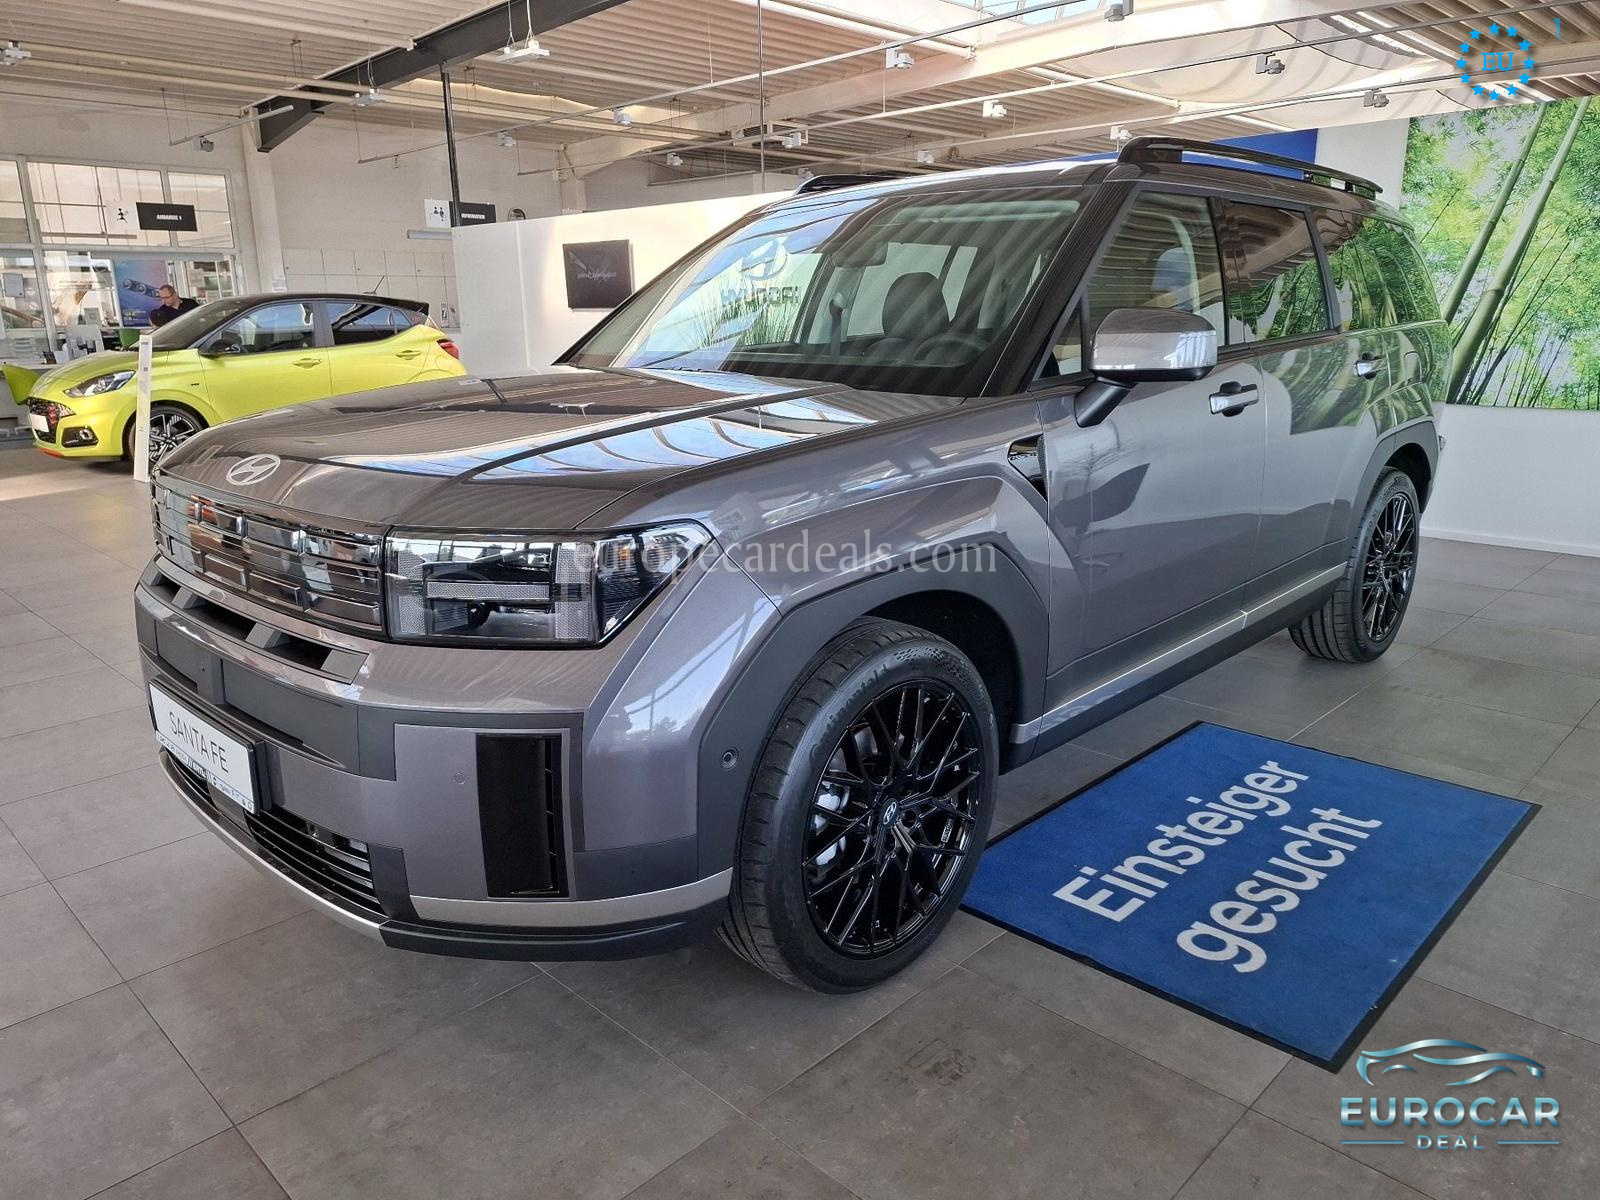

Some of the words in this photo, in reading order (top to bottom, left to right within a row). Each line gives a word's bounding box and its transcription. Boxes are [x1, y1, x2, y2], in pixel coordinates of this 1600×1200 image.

[169, 711, 210, 761] SANTA
[210, 740, 229, 774] FE
[1052, 760, 1311, 923] Einsteiger
[1175, 807, 1383, 973] gesucht
